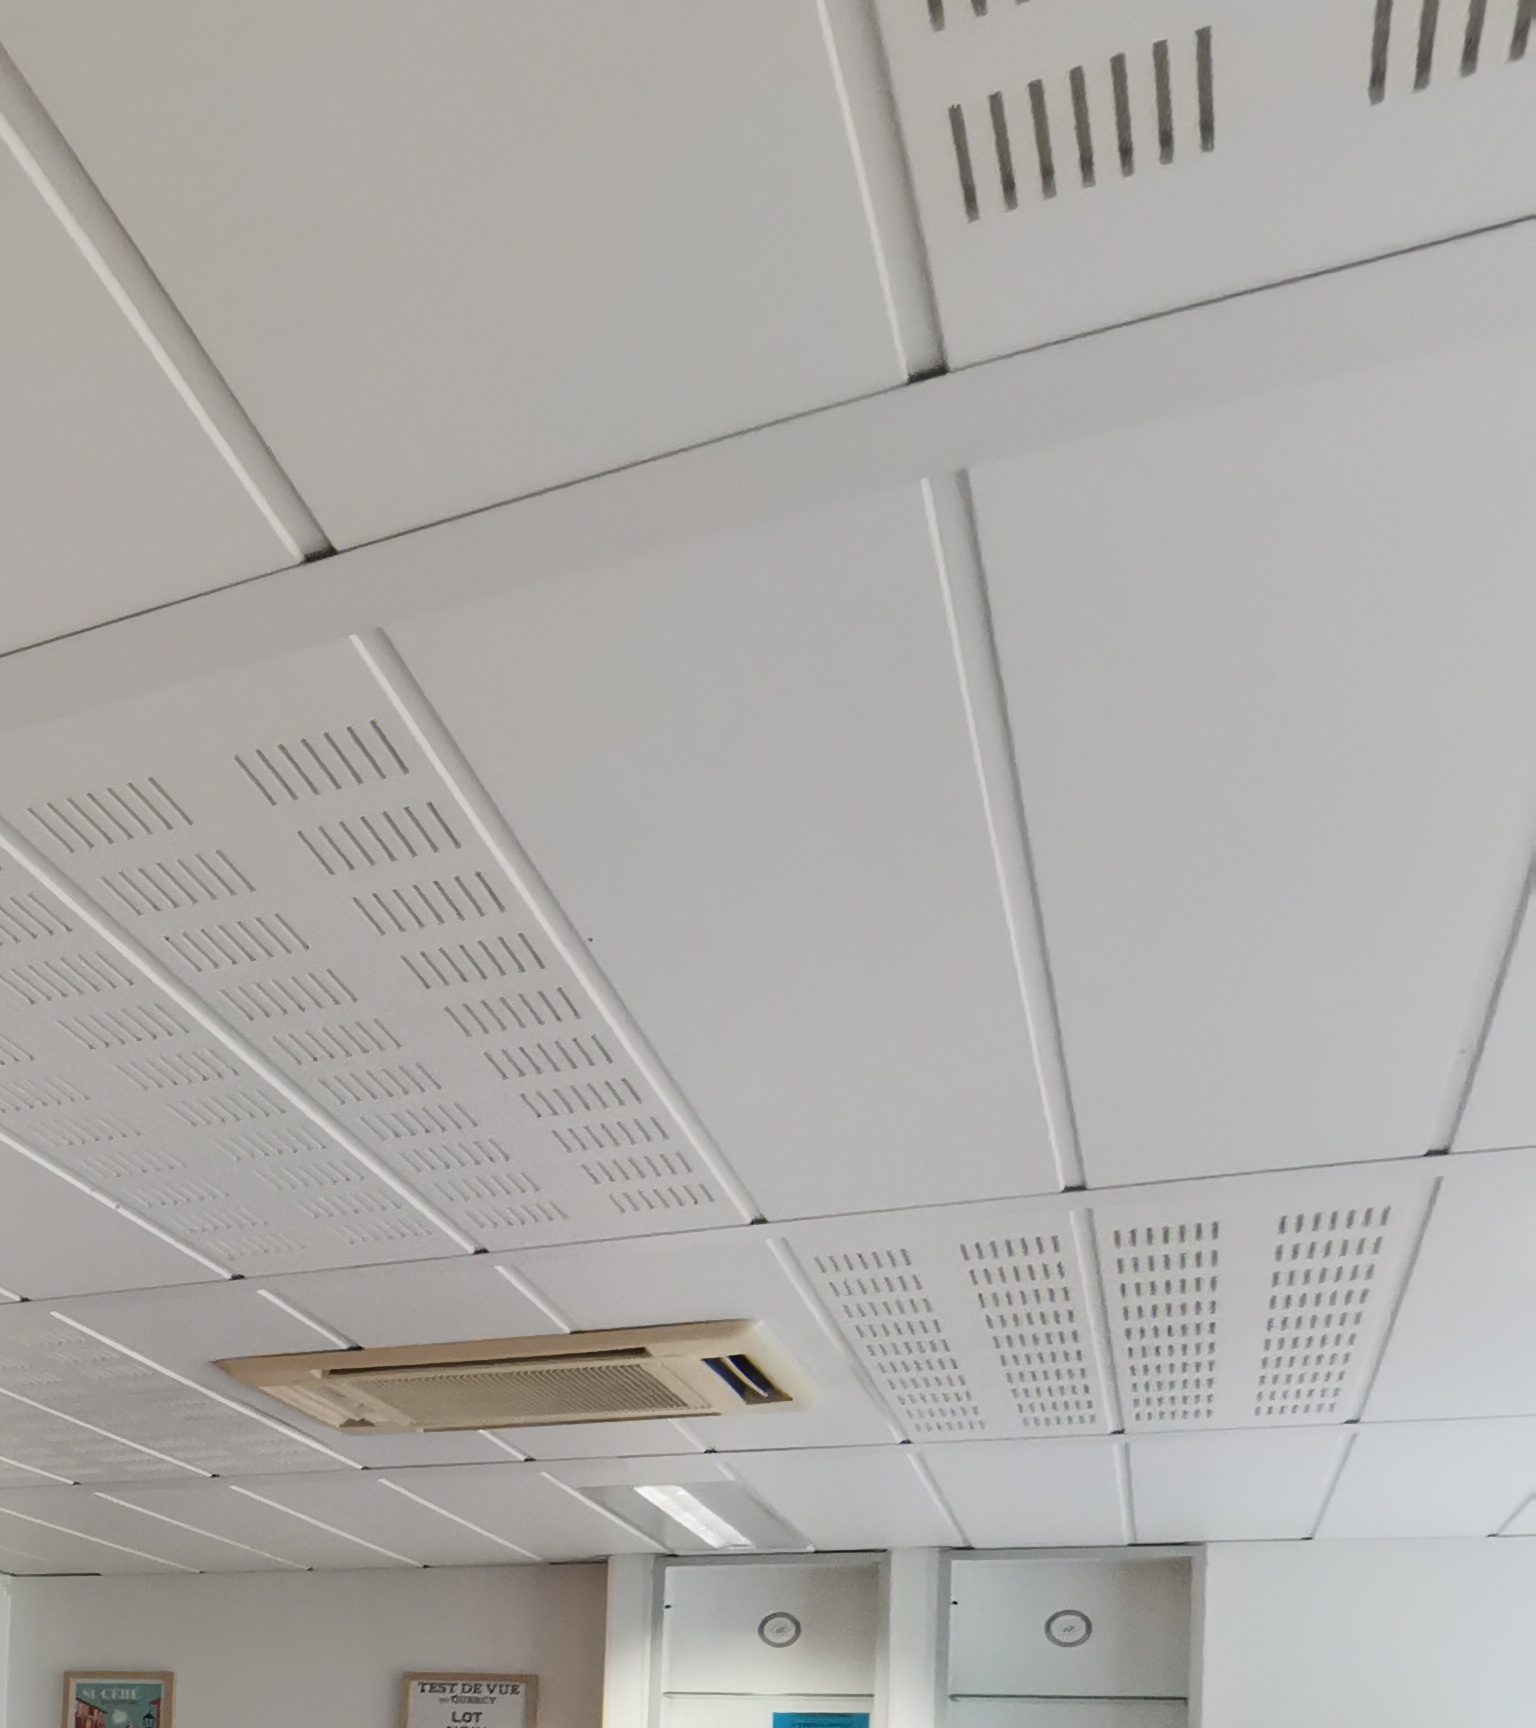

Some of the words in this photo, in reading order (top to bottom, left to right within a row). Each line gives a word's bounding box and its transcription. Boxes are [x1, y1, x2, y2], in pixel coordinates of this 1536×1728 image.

[417, 1681, 458, 1694] TEST
[461, 1682, 483, 1695] DE
[485, 1683, 521, 1696] VUE
[451, 1711, 483, 1723] LOT
